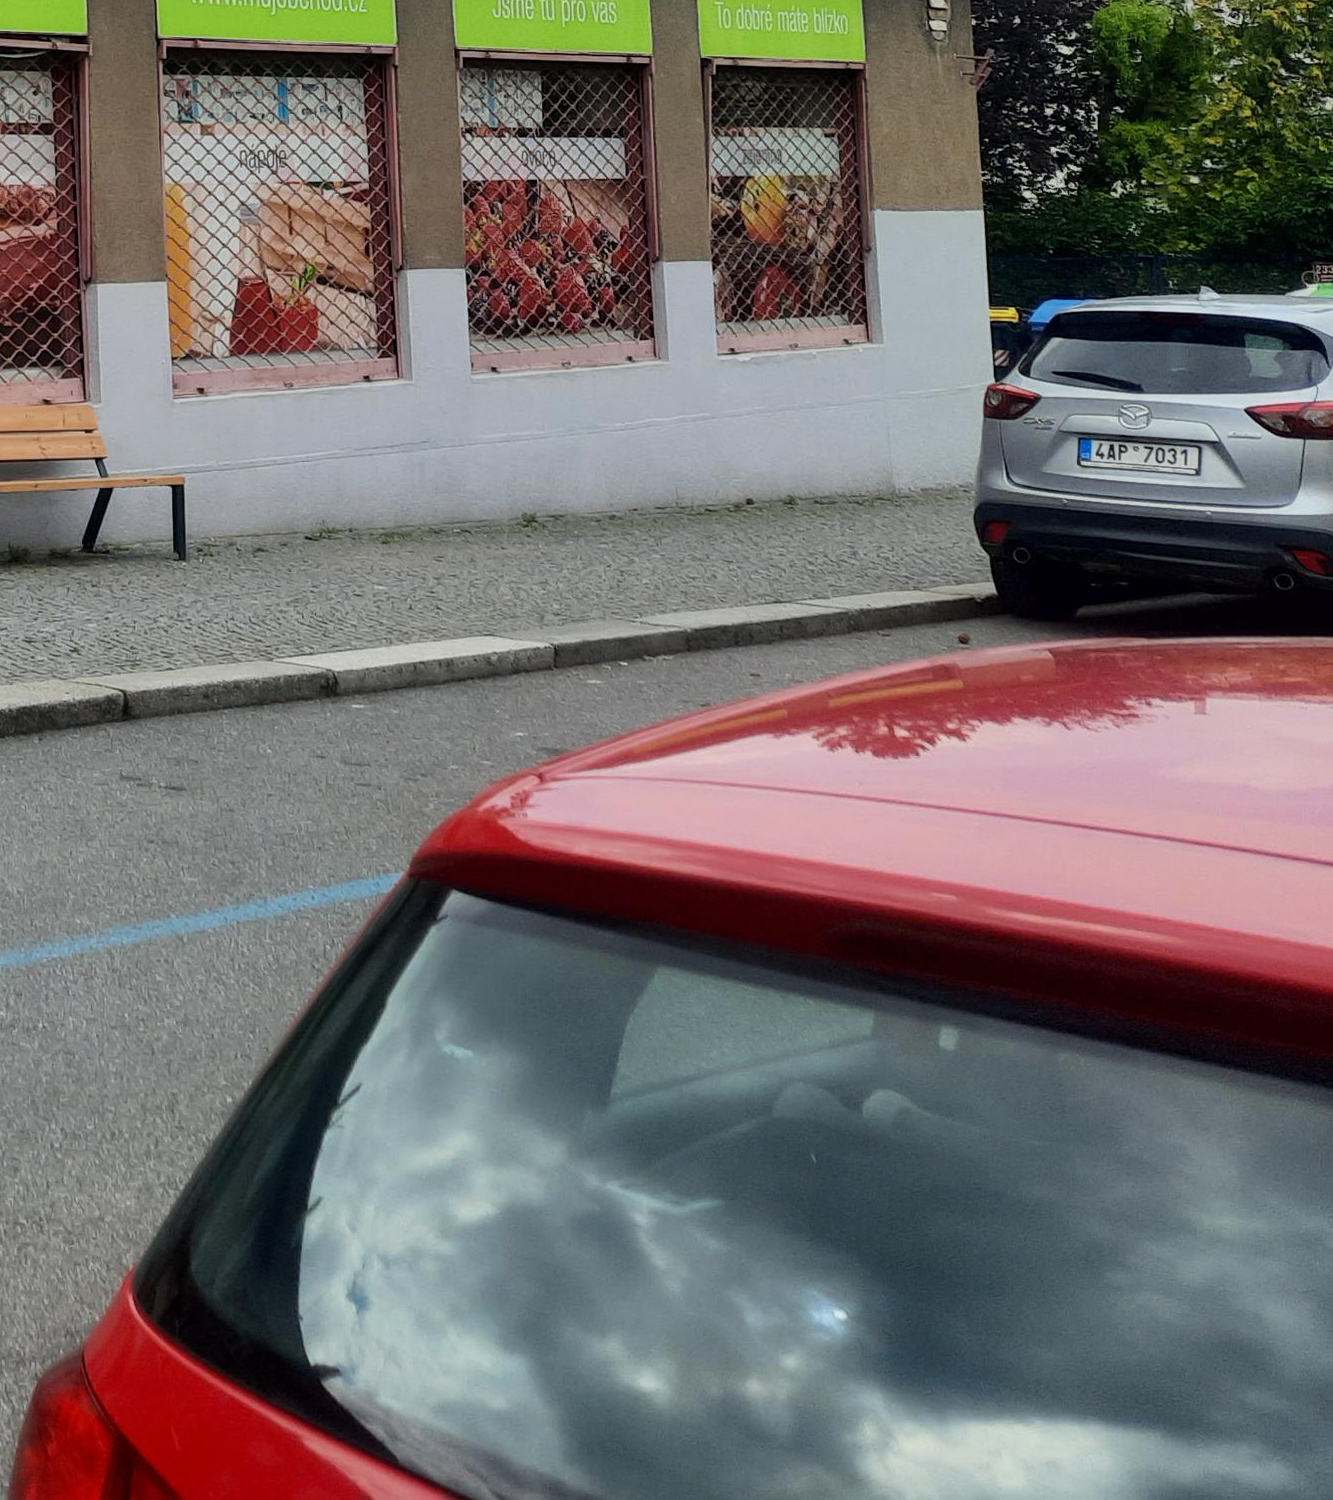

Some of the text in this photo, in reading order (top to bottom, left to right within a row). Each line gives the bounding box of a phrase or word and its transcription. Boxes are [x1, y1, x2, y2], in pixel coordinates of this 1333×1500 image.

[561, 0, 587, 28] pro
[714, 1, 849, 35] To dobré máte blízko
[238, 143, 288, 173] nápoje
[1095, 443, 1189, 466] 4AP 7031
